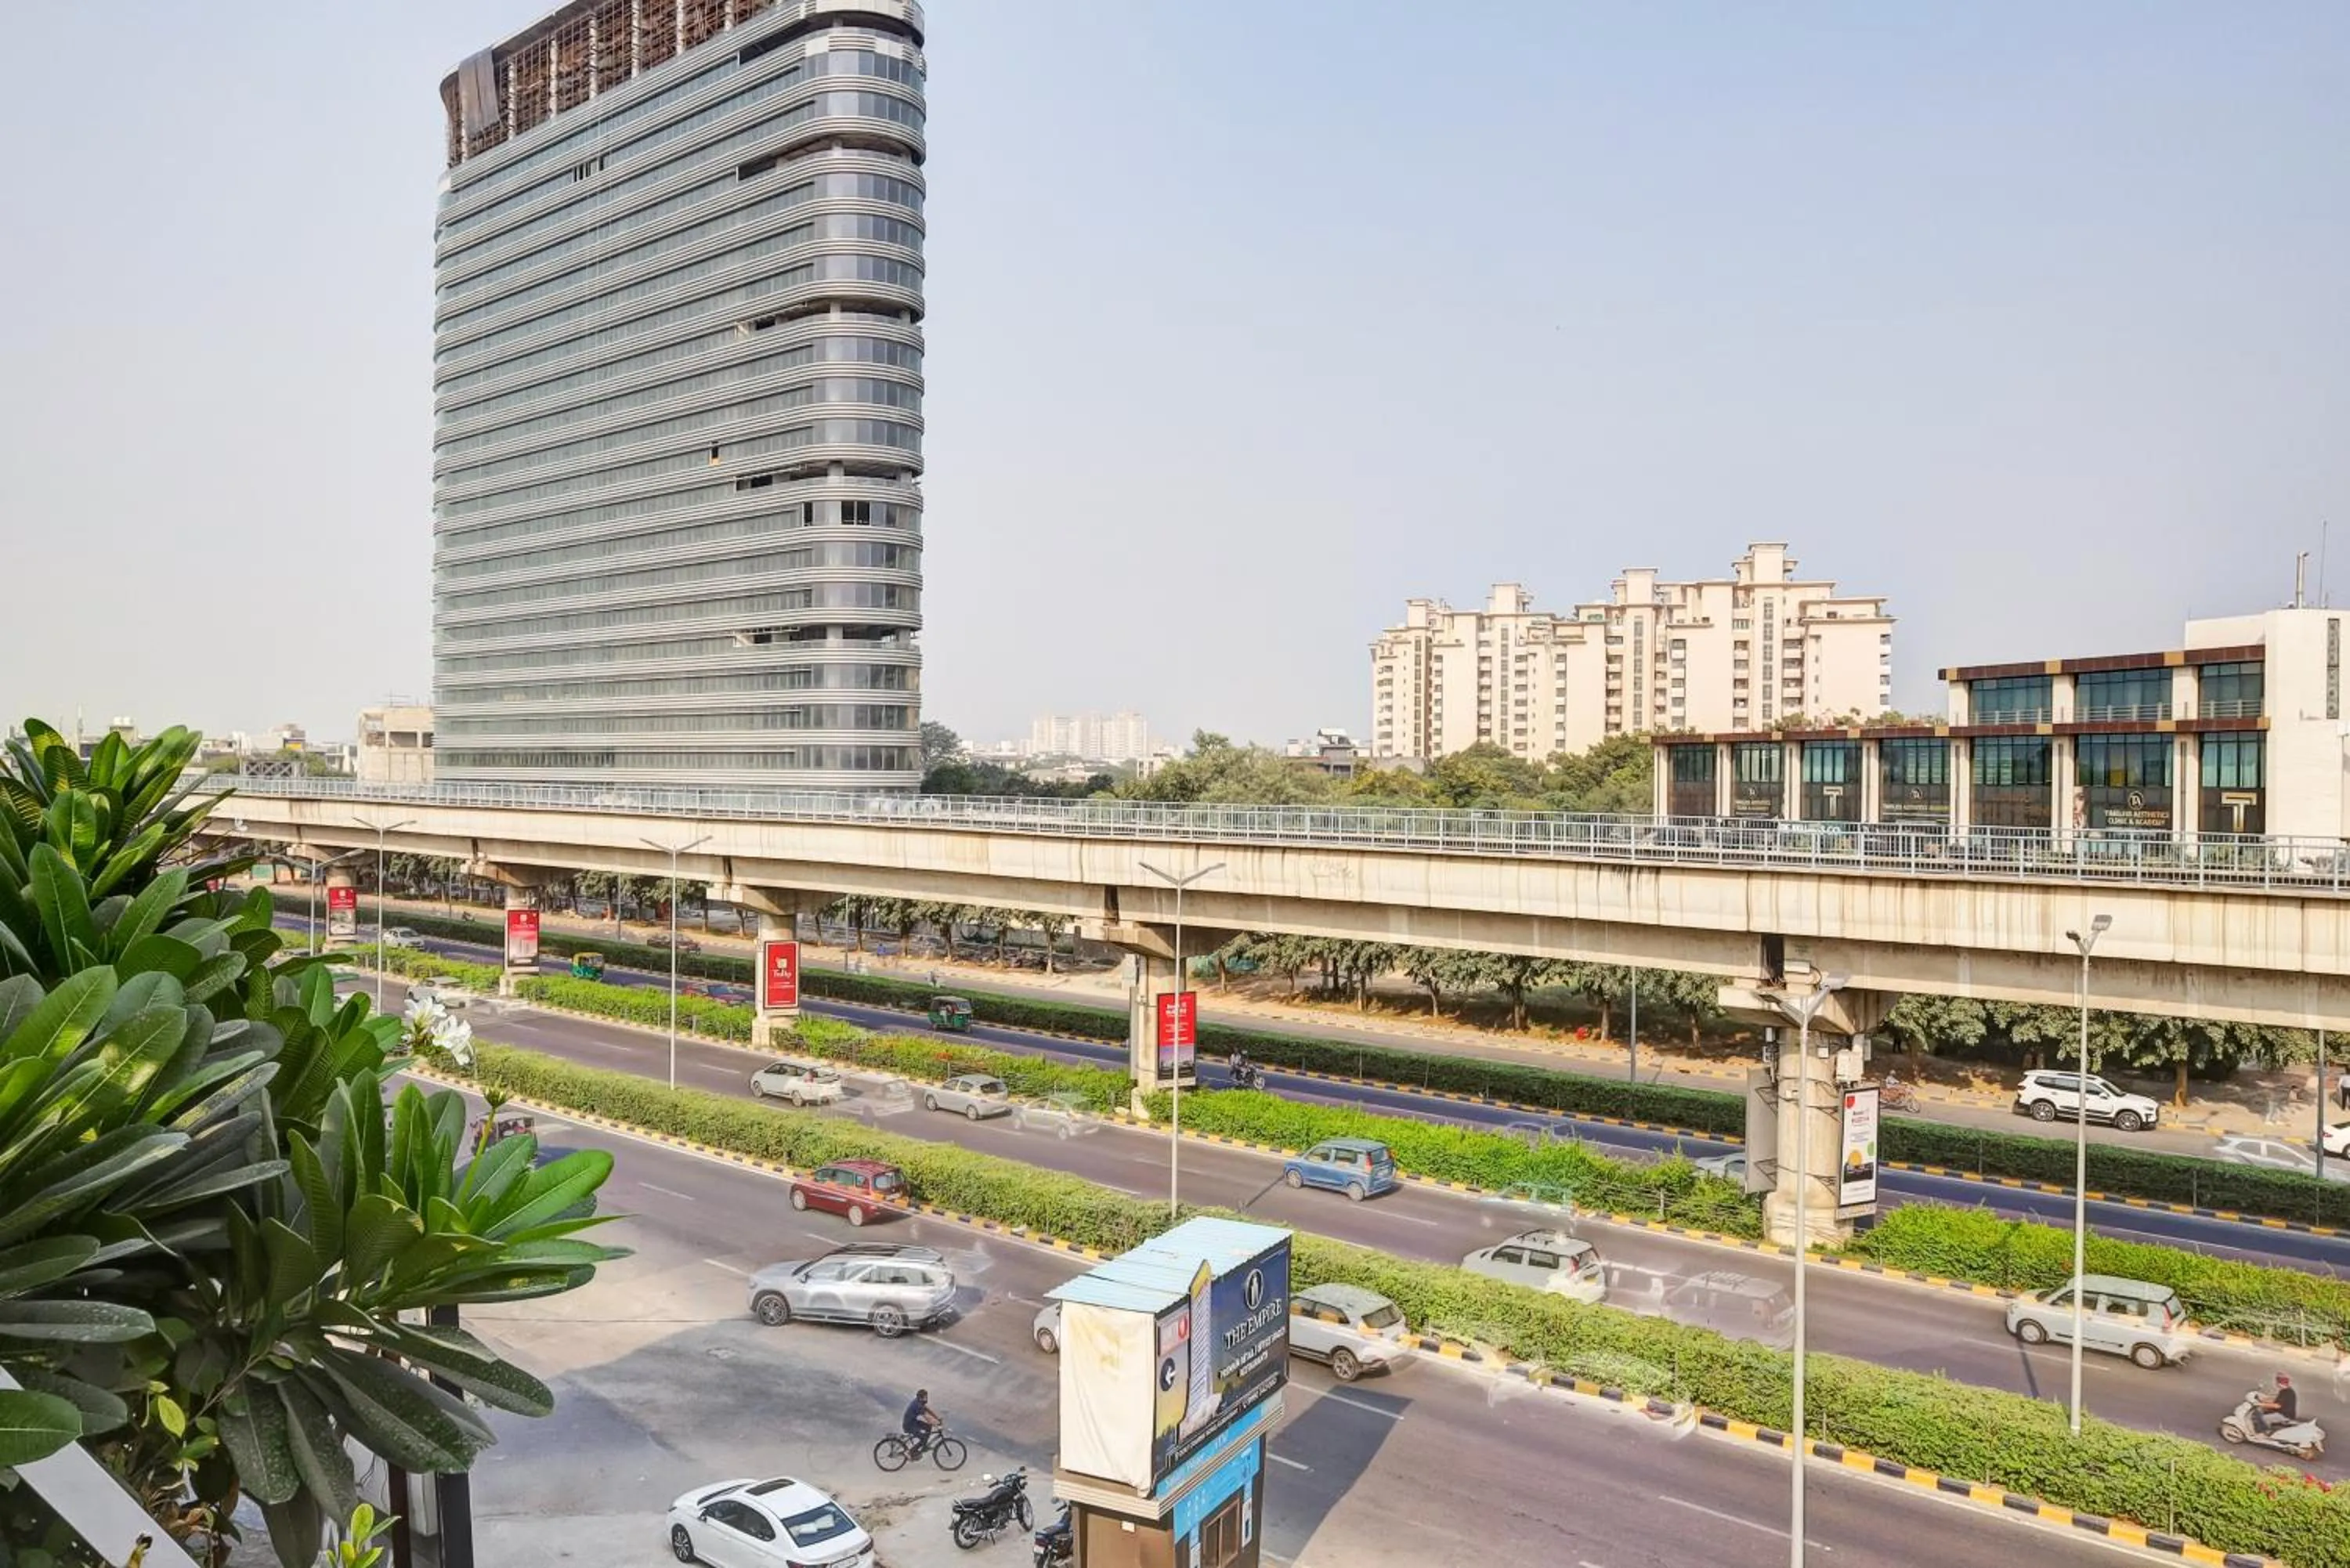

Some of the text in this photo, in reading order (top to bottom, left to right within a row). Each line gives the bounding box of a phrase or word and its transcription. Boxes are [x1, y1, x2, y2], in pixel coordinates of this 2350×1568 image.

[1823, 786, 1843, 818] T
[2221, 792, 2257, 832] T
[1224, 1299, 1282, 1349] THE EMPIRE
